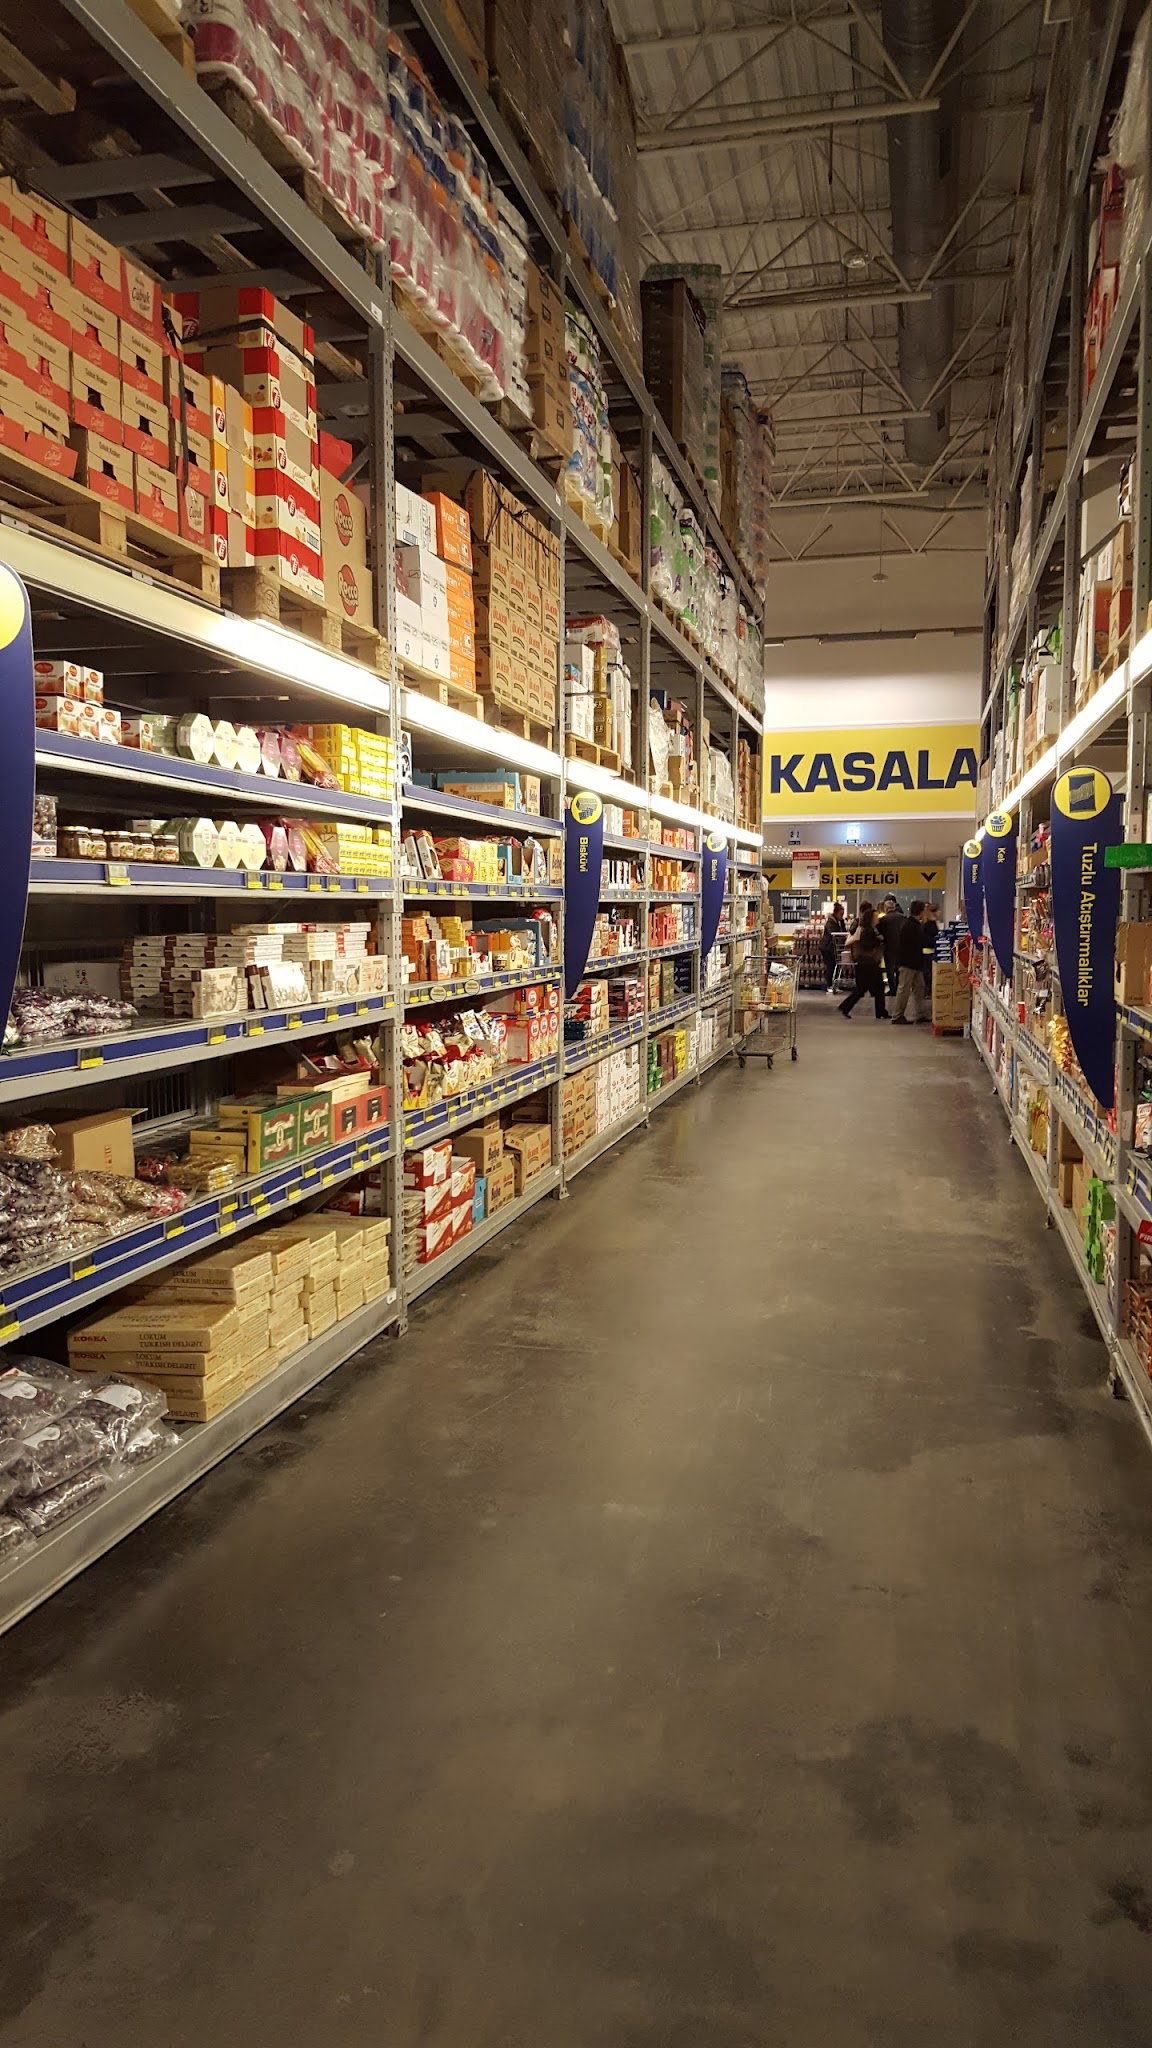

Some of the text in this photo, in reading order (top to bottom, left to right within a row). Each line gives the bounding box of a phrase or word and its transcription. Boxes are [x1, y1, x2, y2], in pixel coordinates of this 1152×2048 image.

[334, 500, 352, 530] Rocco
[338, 571, 358, 600] Rocco
[770, 748, 977, 793] KASALA
[997, 847, 1006, 864] Kek
[846, 870, 899, 886] ŞEFLİĞİ
[1077, 842, 1098, 1007] Tuzlu Atıştırmalıklar
